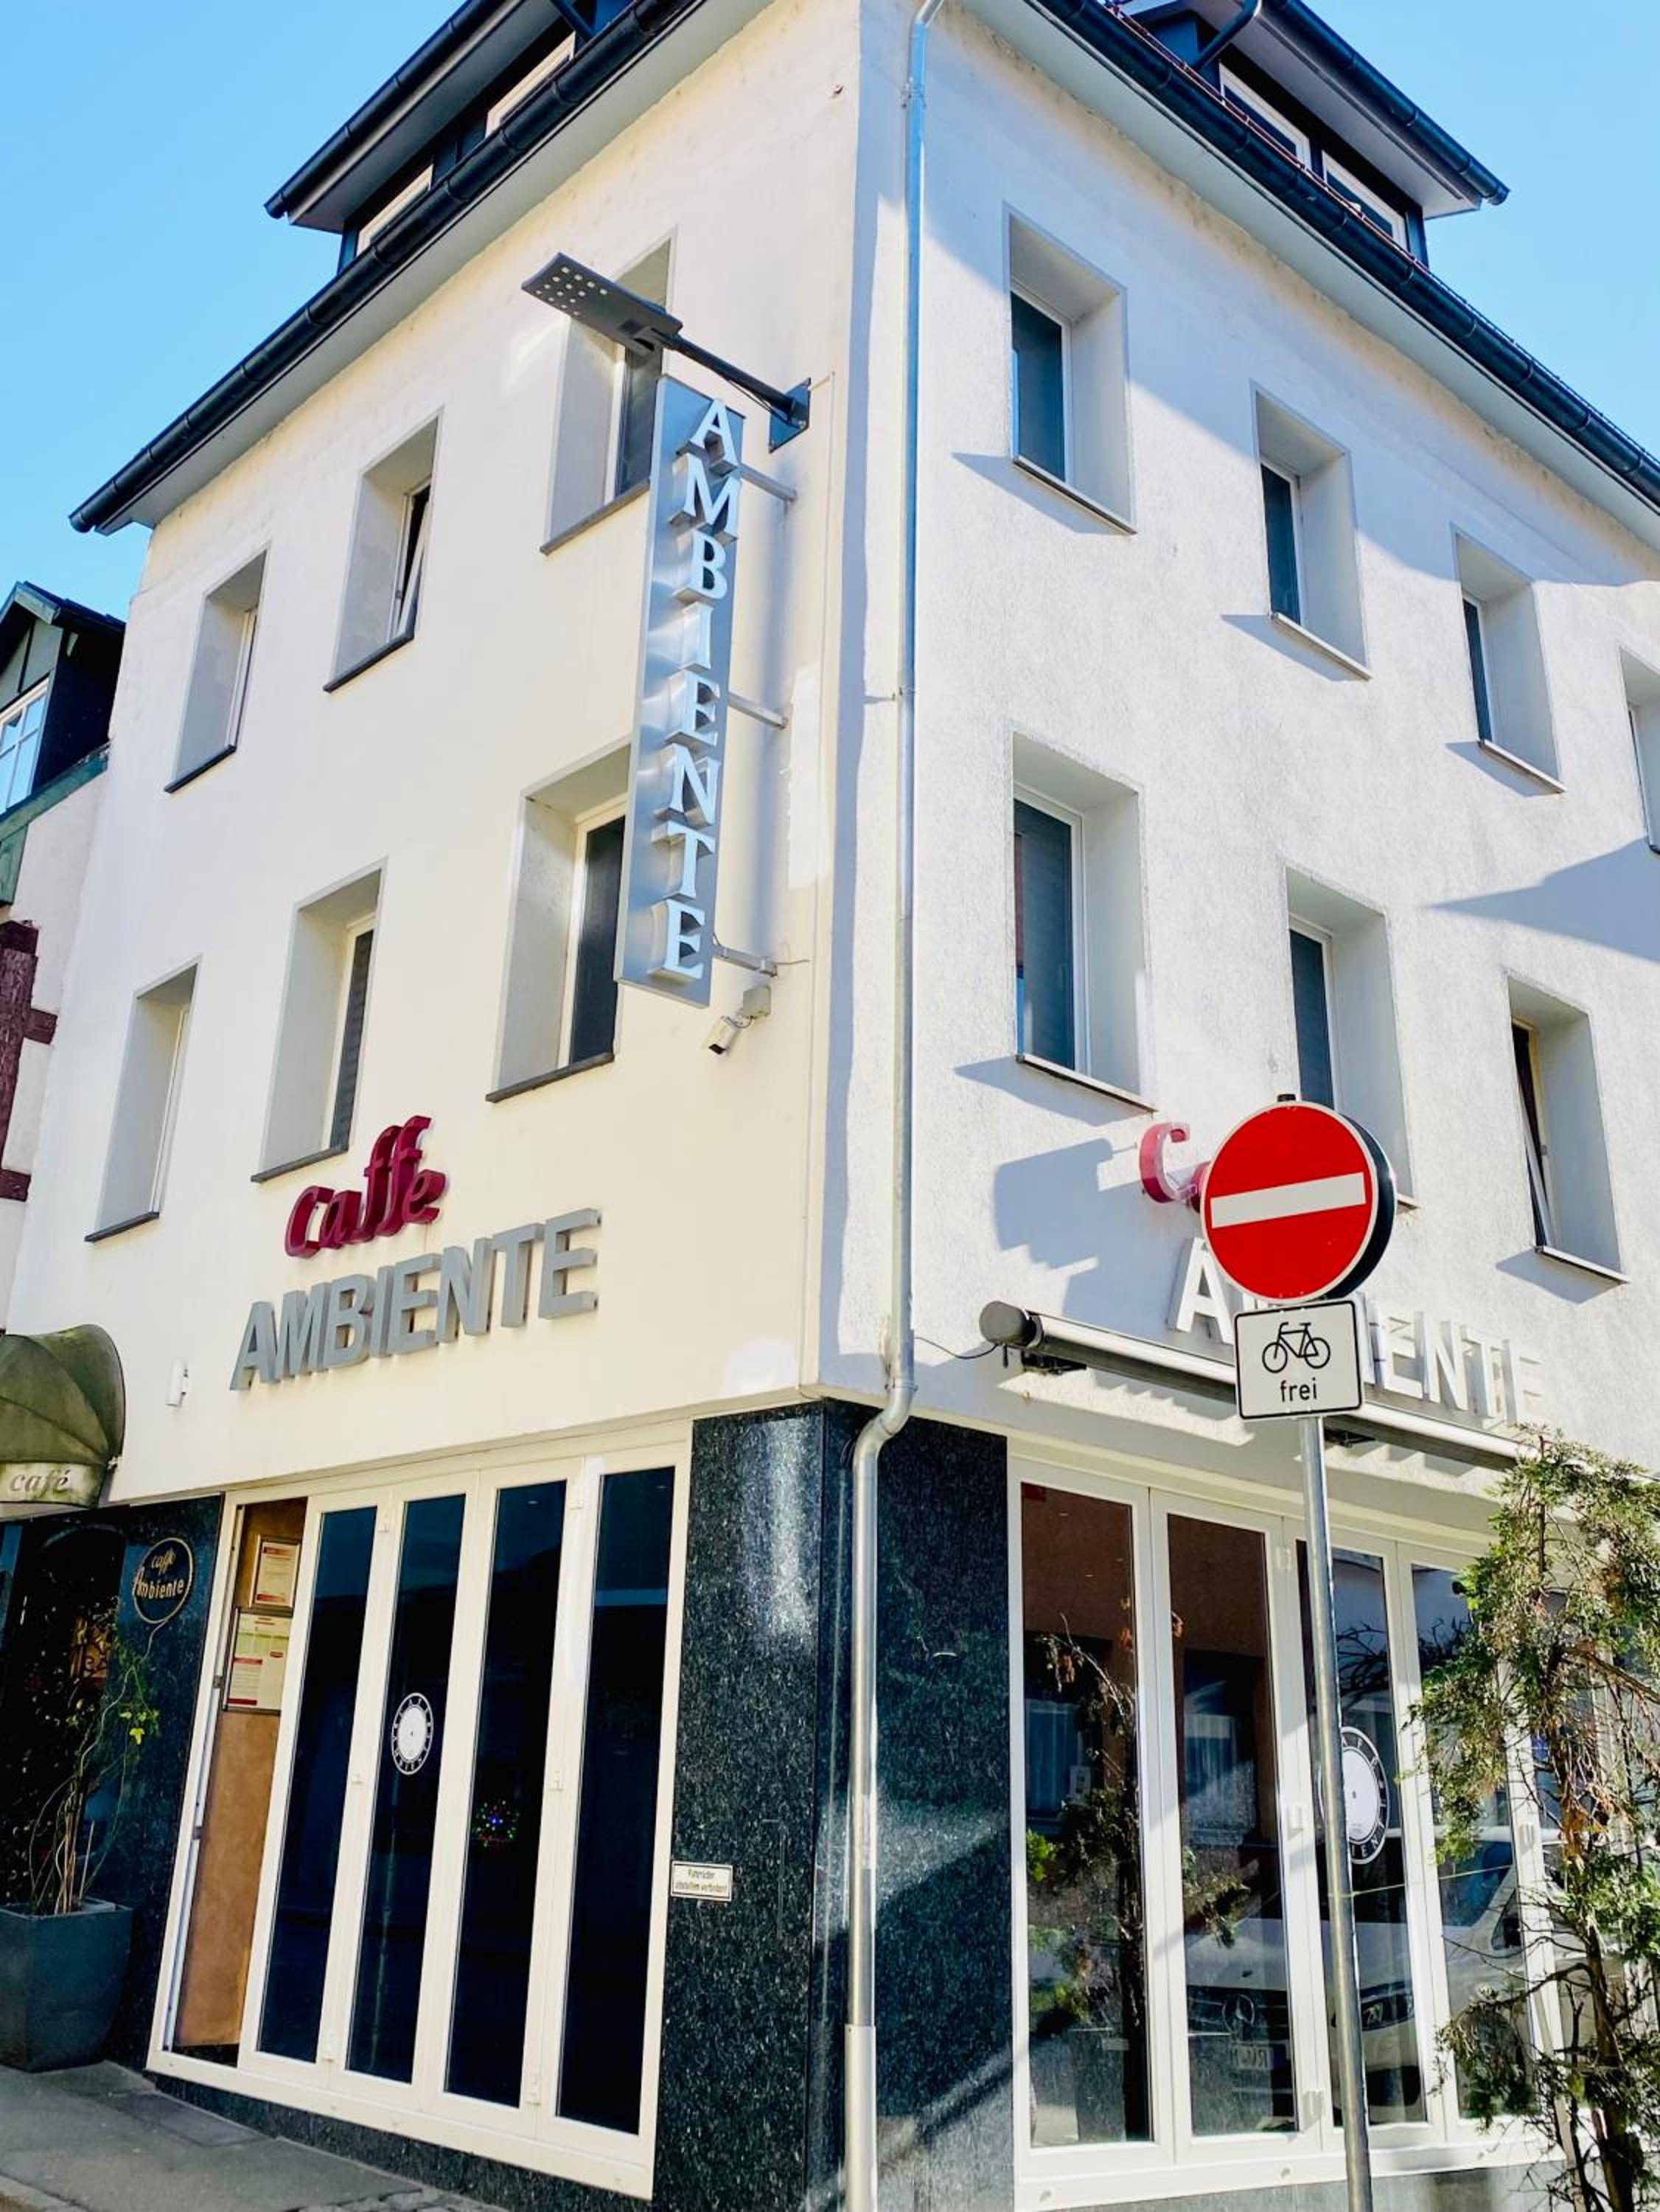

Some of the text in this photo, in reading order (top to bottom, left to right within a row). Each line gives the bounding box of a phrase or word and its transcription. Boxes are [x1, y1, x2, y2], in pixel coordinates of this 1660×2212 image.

[652, 398, 738, 981] AMBIENTE
[230, 1207, 603, 1392] AMBIENTE
[1166, 1237, 1548, 1427] AIENTE
[1280, 1377, 1318, 1402] frei
